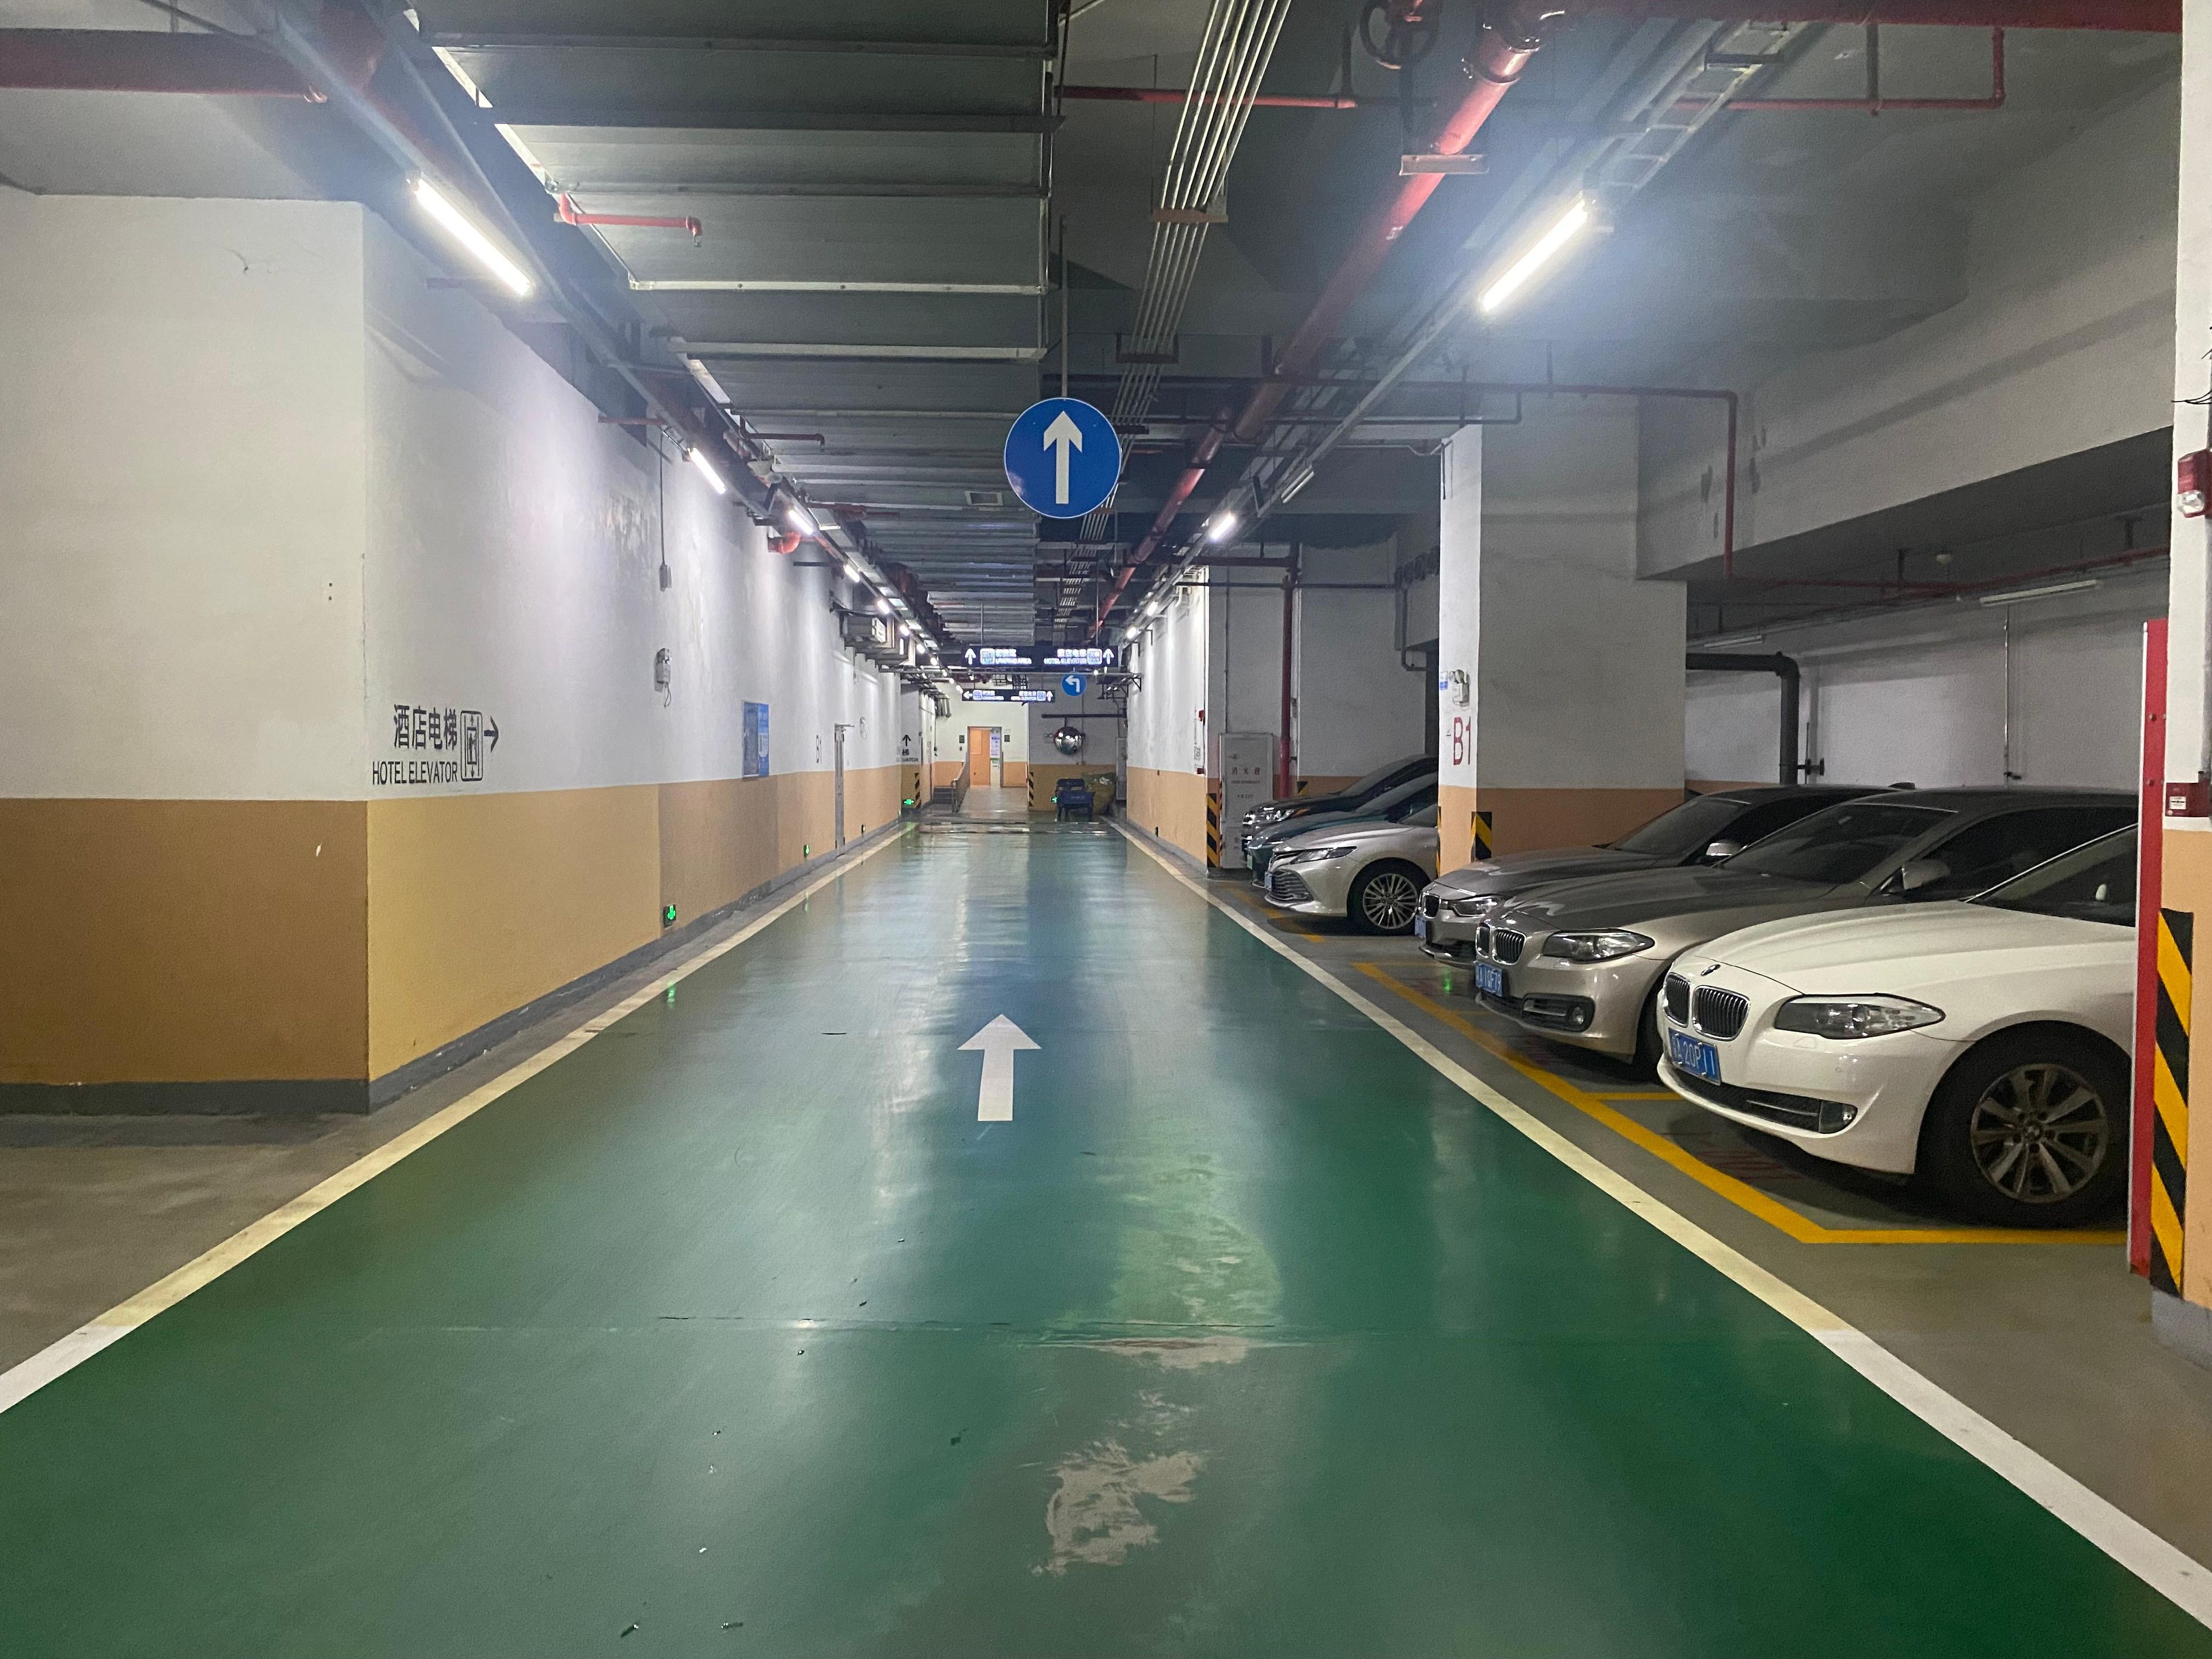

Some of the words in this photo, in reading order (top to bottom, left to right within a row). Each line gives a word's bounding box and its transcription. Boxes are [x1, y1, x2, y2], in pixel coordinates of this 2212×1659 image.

[393, 704, 457, 751] 酒店电梯
[1453, 717, 1471, 766] B1
[372, 761, 407, 785] HOTEL
[408, 761, 458, 784] ELEVATOR
